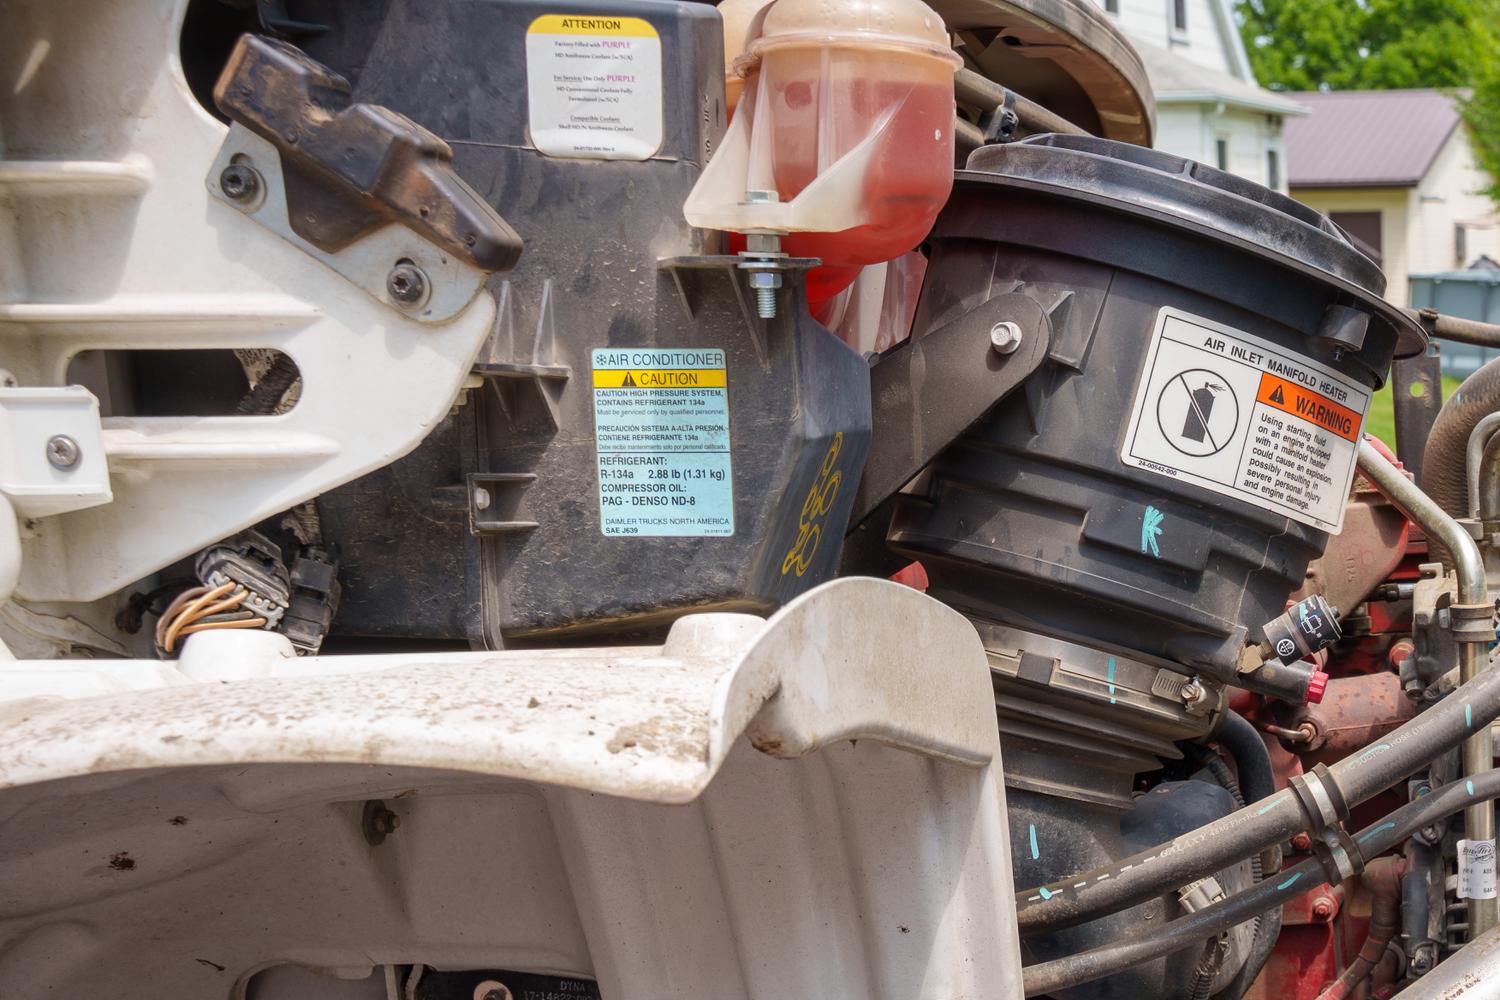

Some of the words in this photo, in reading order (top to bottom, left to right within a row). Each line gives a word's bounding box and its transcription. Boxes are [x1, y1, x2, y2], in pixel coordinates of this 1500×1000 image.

[562, 19, 621, 30] ATTENTION
[602, 41, 630, 49] PURPLE
[606, 74, 636, 82] PURPLE
[608, 354, 629, 366] AIR
[632, 354, 723, 366] CONDITIONER
[1204, 337, 1226, 352] AIR
[1230, 345, 1264, 366] INLET
[1268, 358, 1316, 388] MANIFOLD
[1318, 378, 1348, 402] HEATER
[640, 372, 698, 386] CAUTION
[1296, 394, 1352, 435] WARNING
[1261, 412, 1284, 430] Using
[1286, 424, 1312, 441] starting
[1314, 433, 1326, 446] fluid
[1255, 435, 1272, 448] with
[1281, 446, 1308, 462] manifold
[1310, 456, 1326, 470] heater
[1258, 425, 1268, 434] on
[1270, 430, 1280, 440] an
[1282, 434, 1304, 449] engine
[1306, 444, 1331, 461] equipped
[600, 456, 668, 466] REFRIGERANT:
[1138, 460, 1178, 477] 24-00542-000
[1252, 447, 1274, 460] could
[1275, 456, 1296, 469] cause
[1296, 464, 1304, 472] an
[600, 470, 634, 479] R-134a
[648, 470, 668, 479] 2.88
[671, 469, 681, 479] lb
[683, 469, 706, 480] (1.31
[710, 469, 726, 480] kg)
[1248, 458, 1282, 476] possibly
[1284, 470, 1311, 489] resulting
[1312, 481, 1318, 490] in
[601, 484, 666, 492] COMPRESSOR
[668, 484, 687, 492] OIL:
[1244, 478, 1259, 490] and
[1262, 486, 1284, 500] engine
[1286, 496, 1310, 510] damage.
[1246, 468, 1272, 483] severe
[1274, 480, 1303, 496] personal
[1304, 490, 1322, 504] injury
[602, 496, 623, 506] PAG
[632, 496, 668, 506] DENSO
[671, 496, 696, 506] ND-8
[1160, 832, 1206, 858] GALAXY
